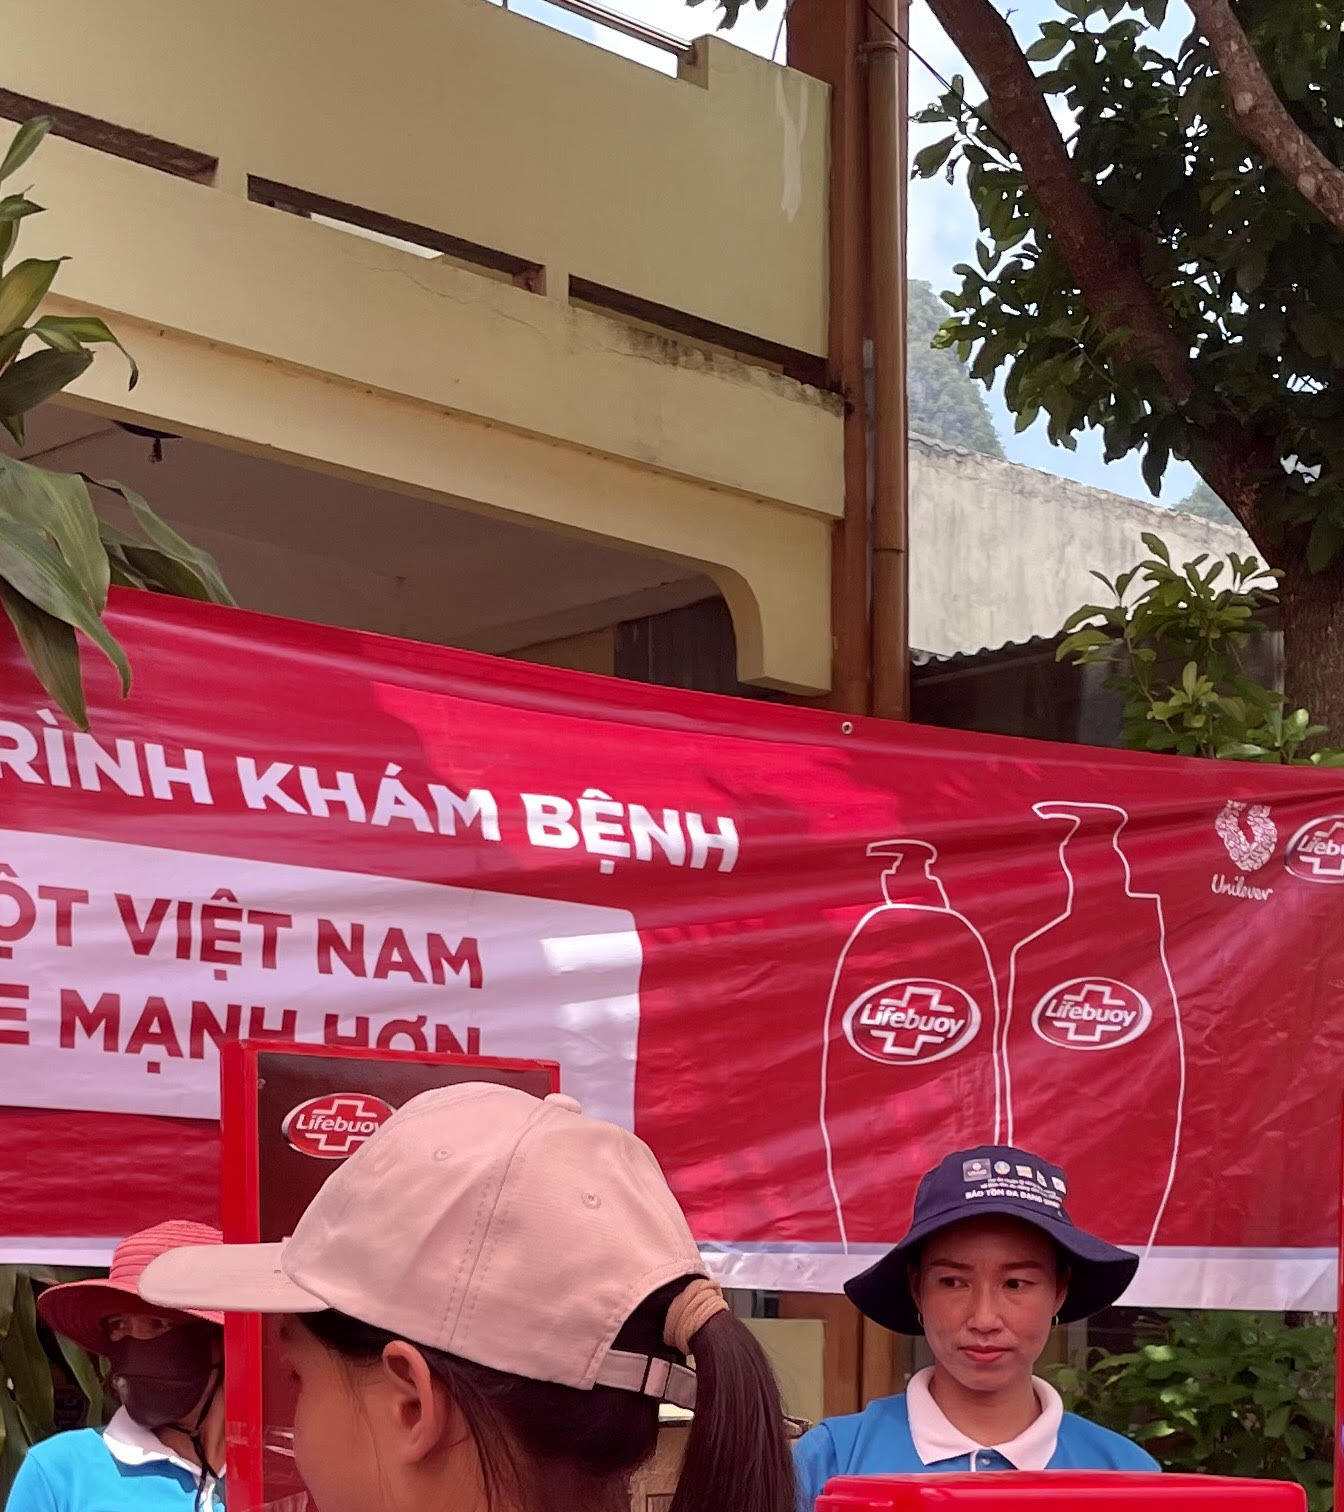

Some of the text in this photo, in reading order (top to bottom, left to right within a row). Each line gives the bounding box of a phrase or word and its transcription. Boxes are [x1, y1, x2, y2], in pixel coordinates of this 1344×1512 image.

[235, 756, 502, 842] KHÁM
[520, 788, 741, 875] BỆNH
[1210, 873, 1274, 901] Unilever
[114, 887, 293, 982] VIỆT
[316, 918, 485, 990] NAM
[859, 1003, 966, 1039] Lifebuoy
[1044, 999, 1137, 1027] Lifebuoy
[59, 989, 298, 1075] MẠNH
[295, 1113, 380, 1133] Lifebuo
